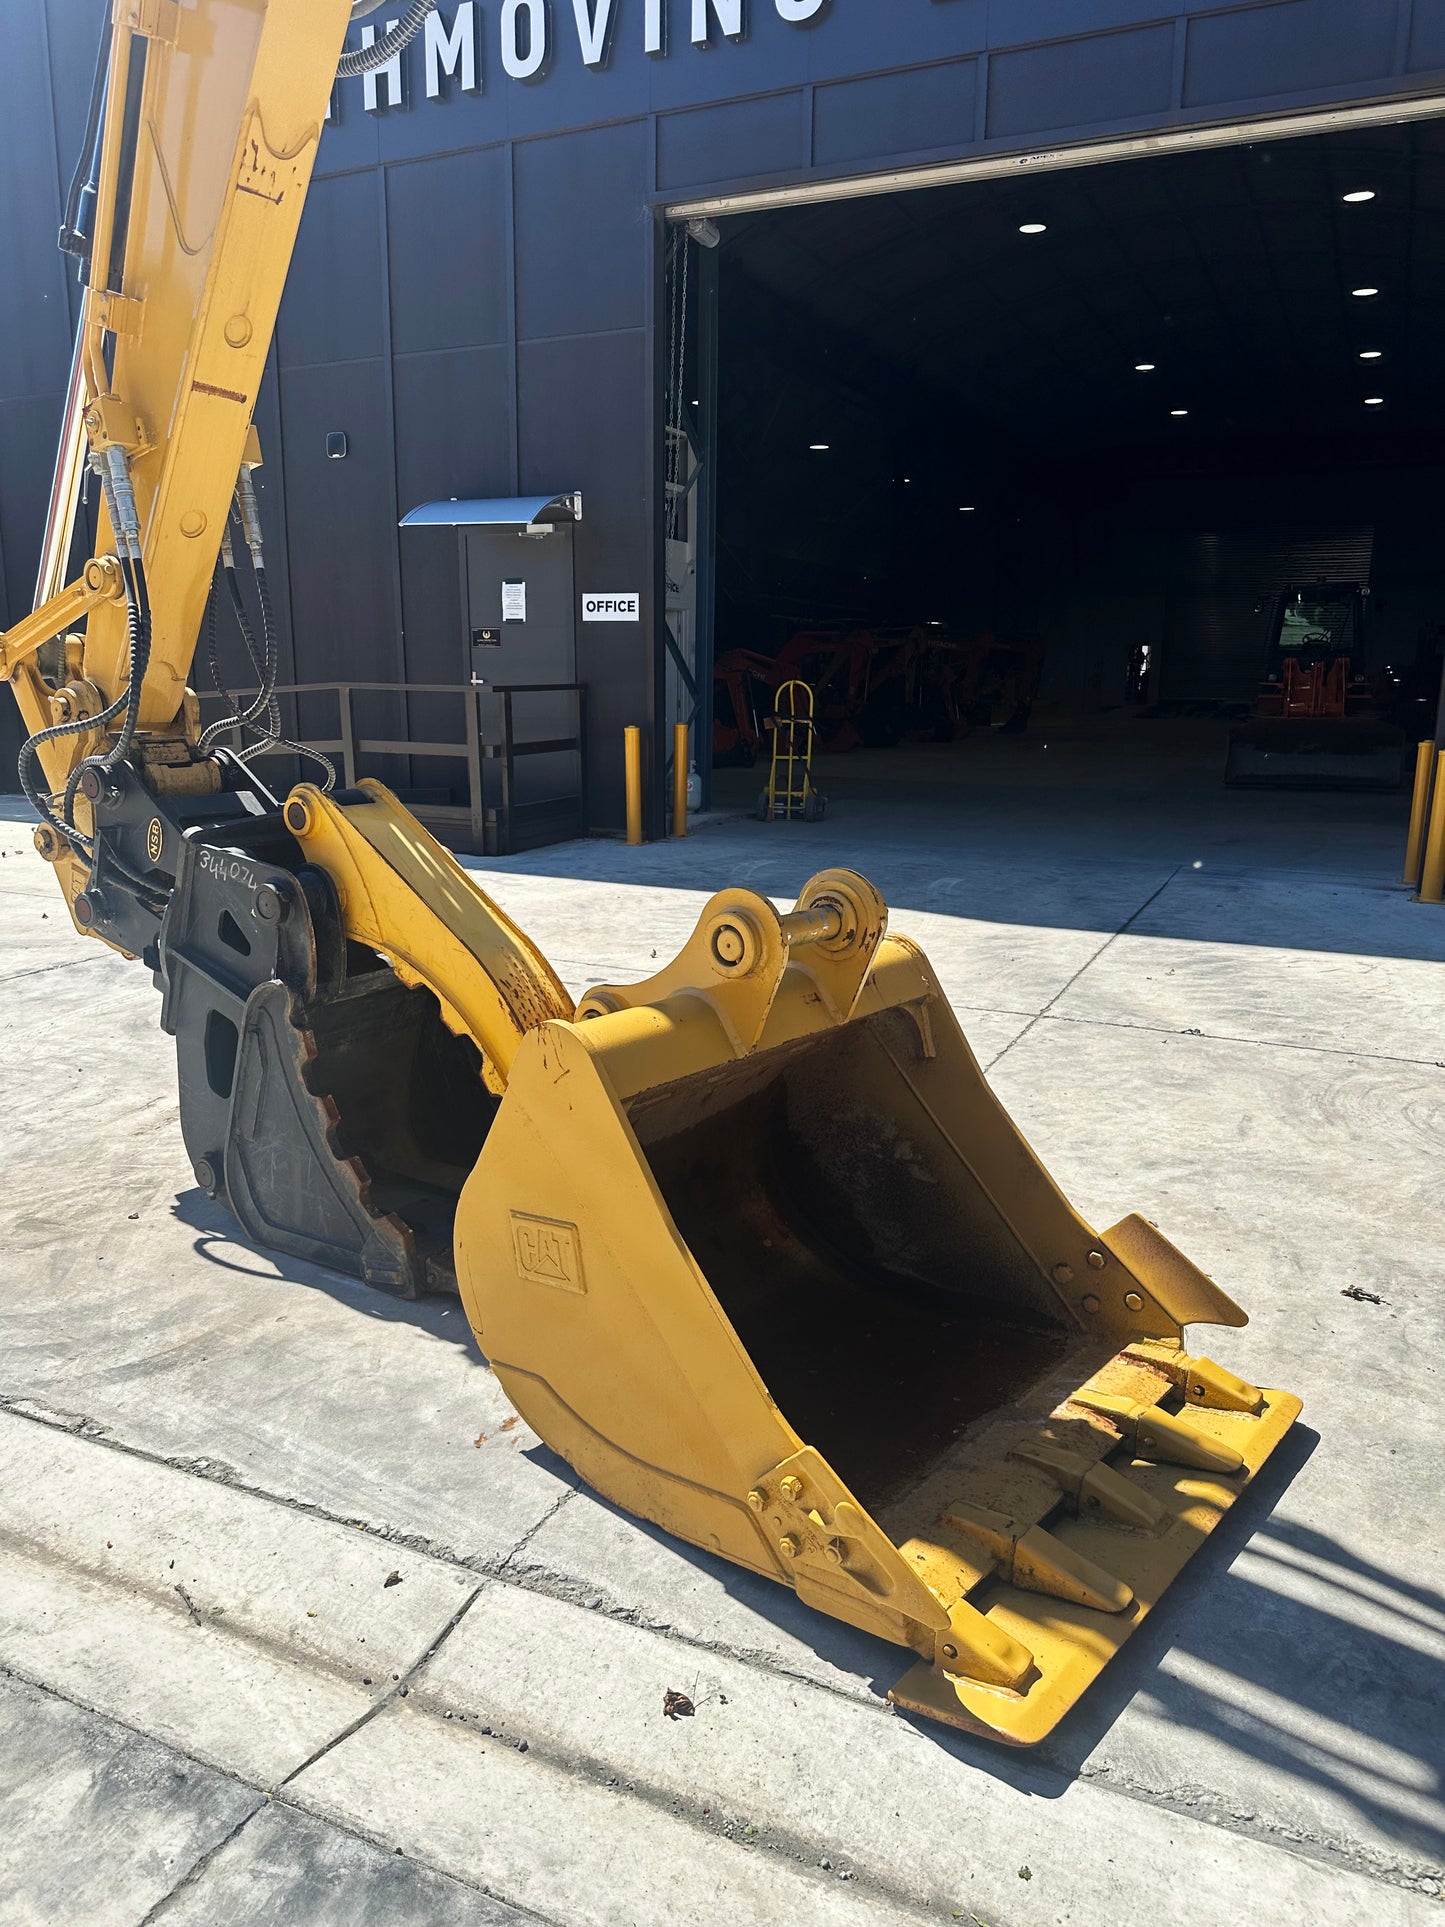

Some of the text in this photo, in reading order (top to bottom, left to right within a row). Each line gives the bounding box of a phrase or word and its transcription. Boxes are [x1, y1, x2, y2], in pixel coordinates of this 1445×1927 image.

[586, 600, 636, 613] OFFICE
[199, 850, 258, 891] 344074
[516, 1225, 573, 1283] CAT
